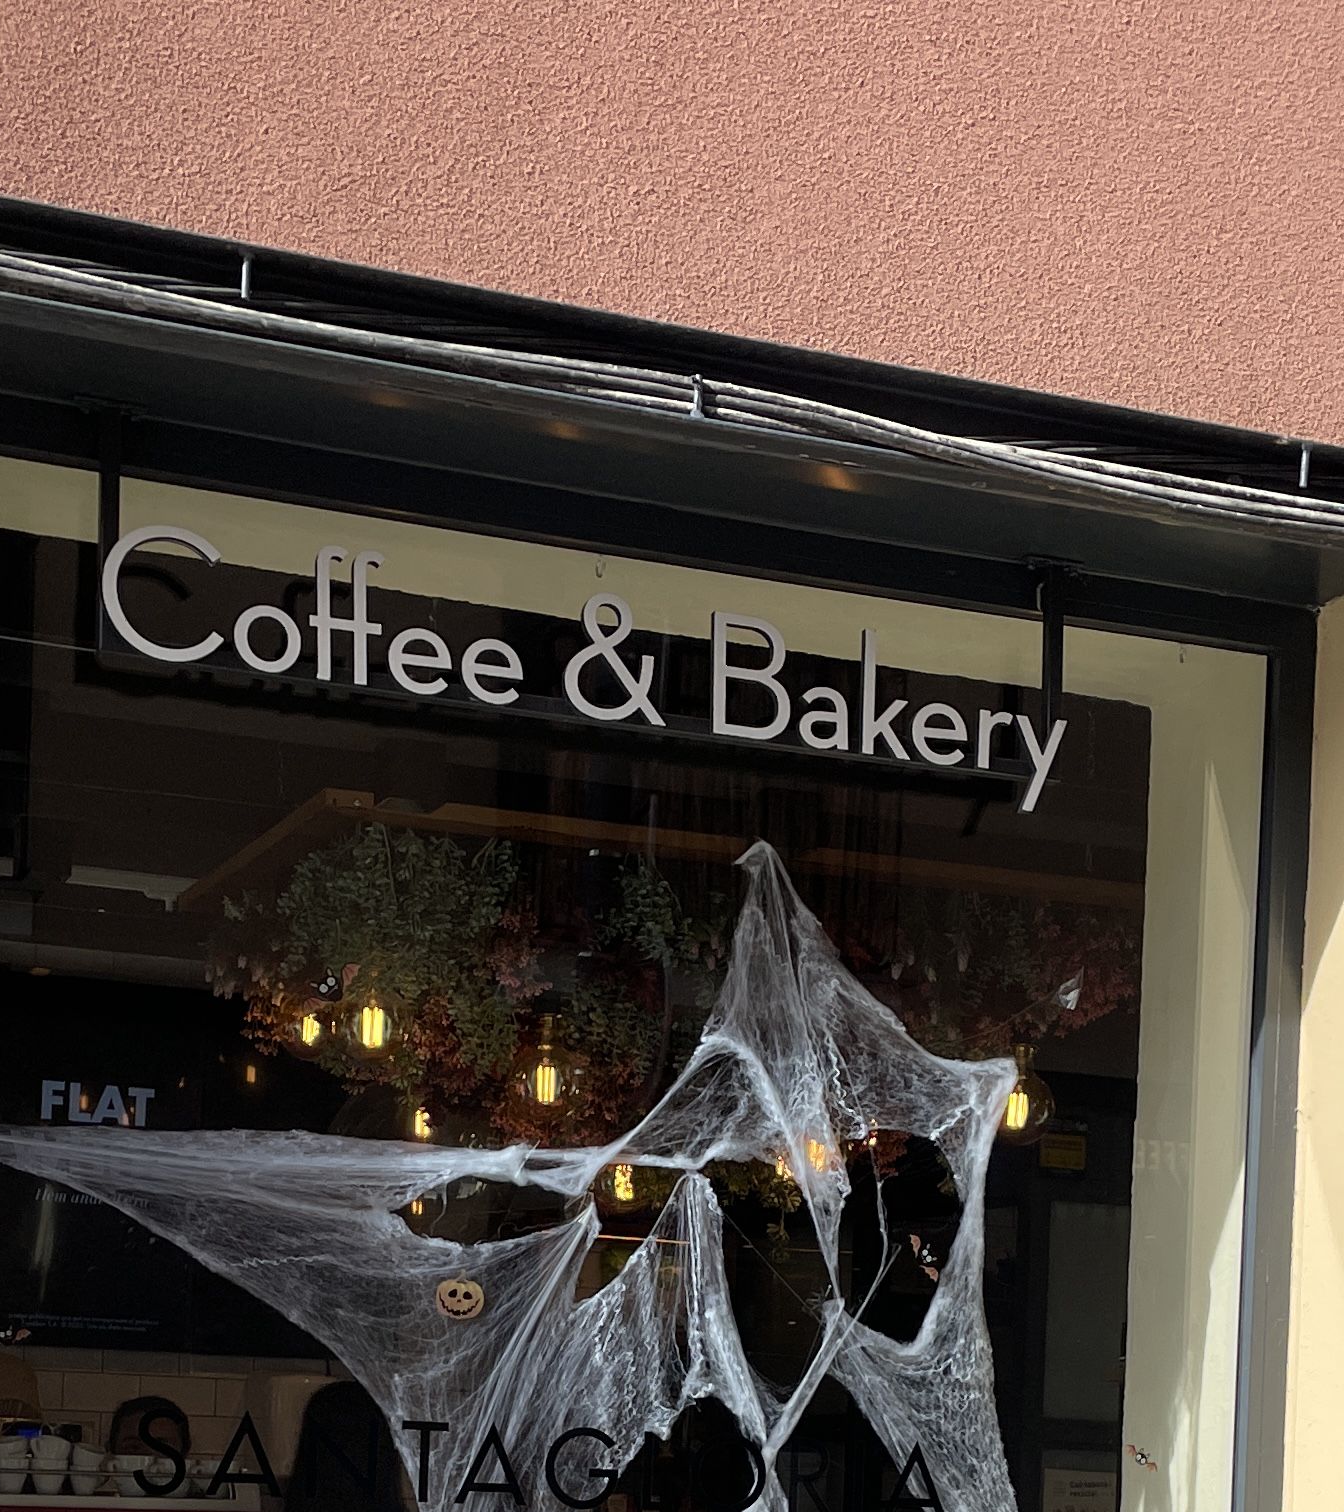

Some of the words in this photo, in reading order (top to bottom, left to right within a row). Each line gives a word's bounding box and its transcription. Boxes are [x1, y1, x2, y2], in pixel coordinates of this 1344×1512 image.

[100, 524, 524, 707] Coffee
[562, 592, 667, 728] &
[710, 609, 1068, 814] Bakery
[39, 1079, 155, 1128] FLAT
